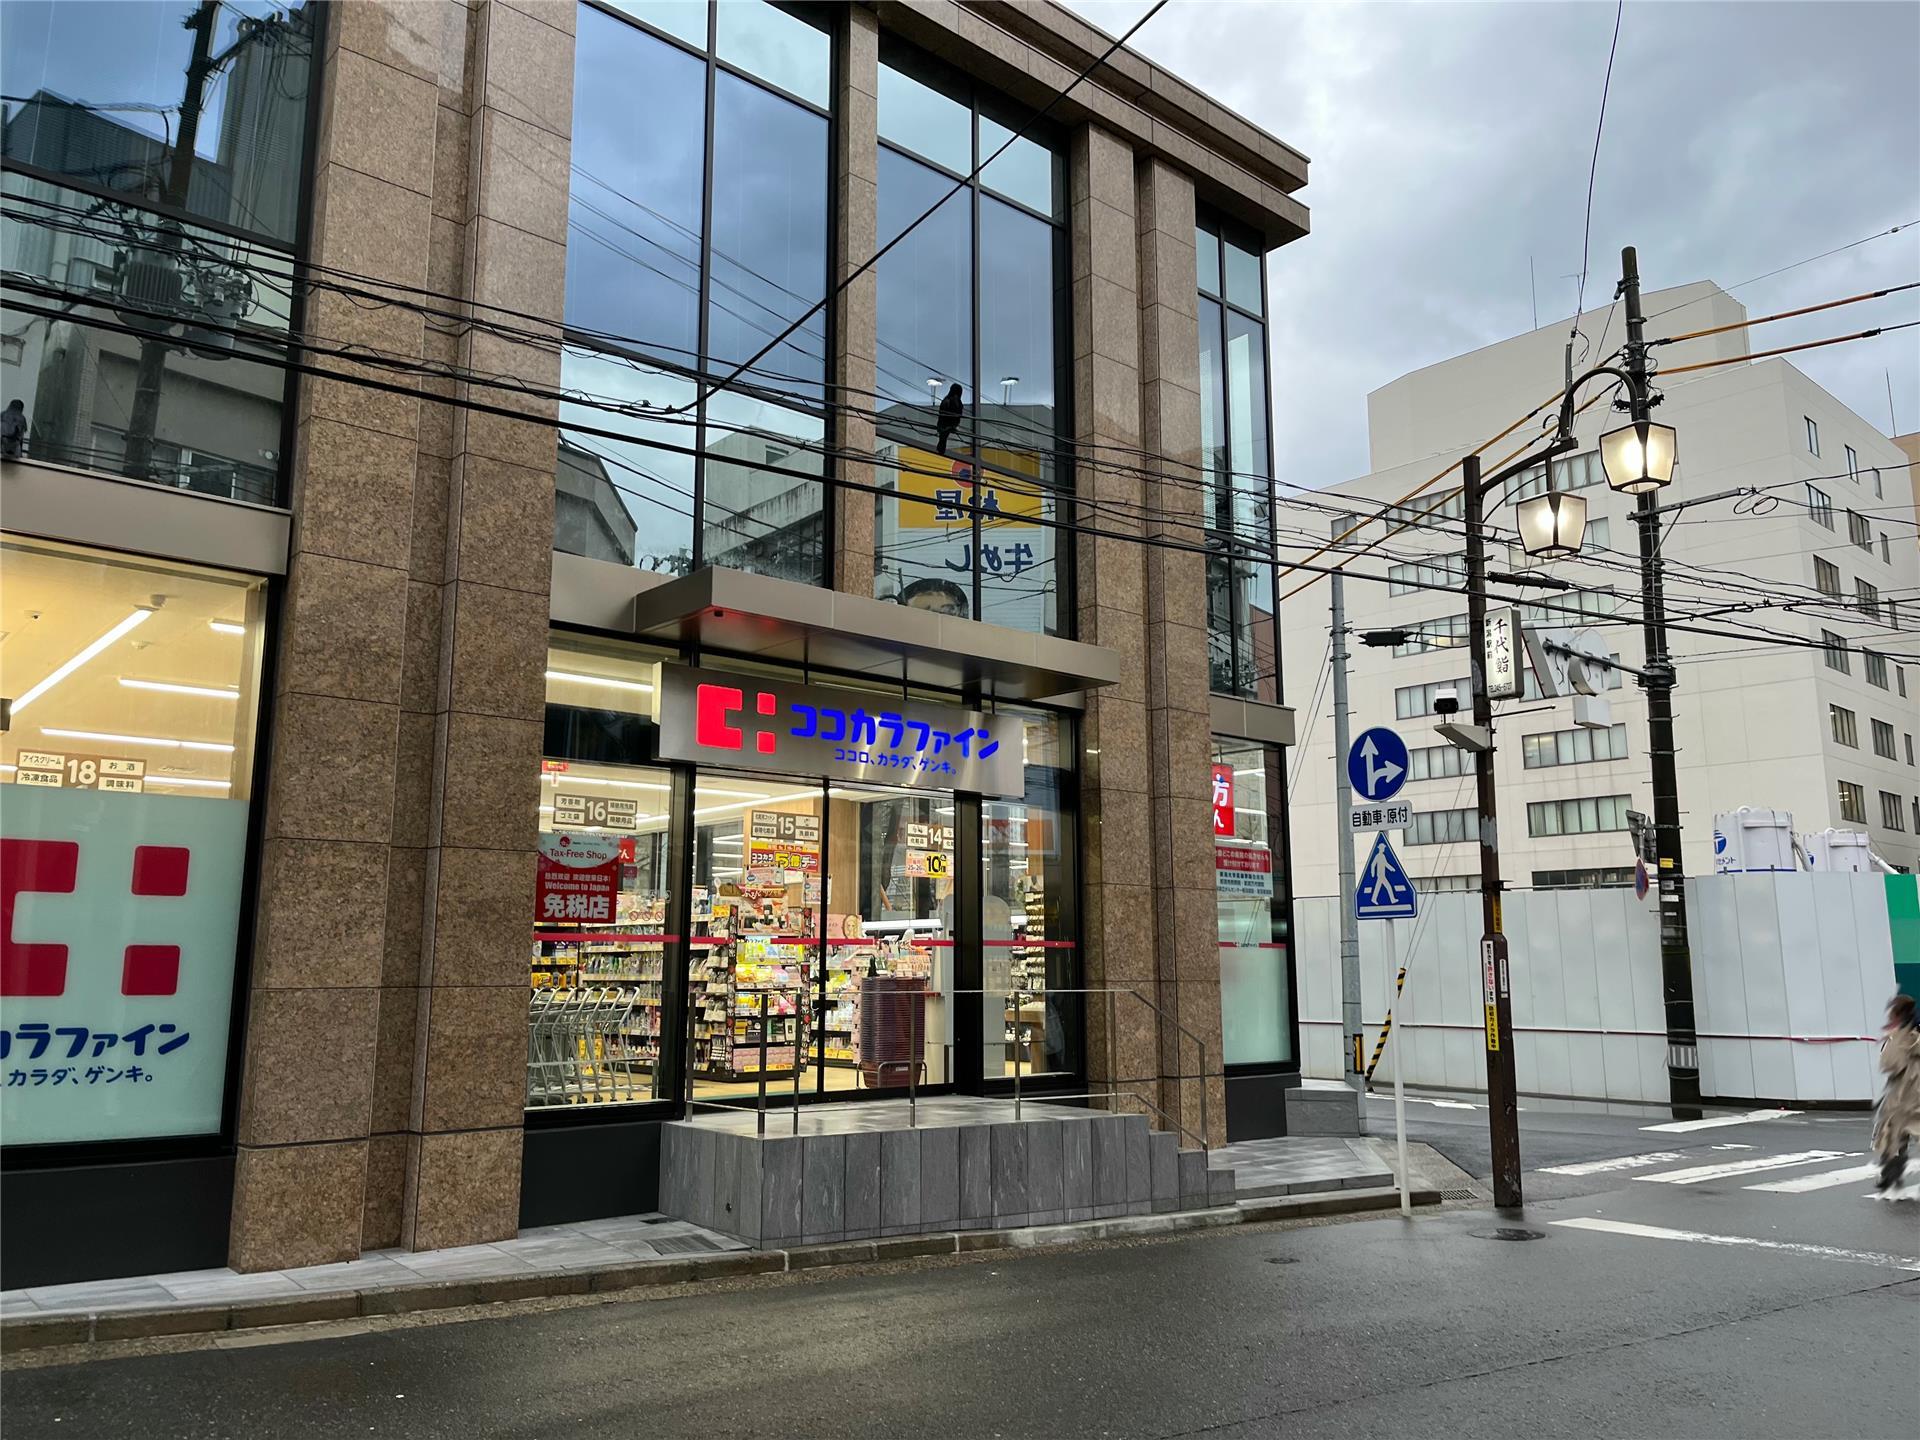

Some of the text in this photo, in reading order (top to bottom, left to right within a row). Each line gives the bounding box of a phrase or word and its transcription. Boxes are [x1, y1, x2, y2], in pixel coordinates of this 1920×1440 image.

[790, 704, 999, 760] ココカラファイン
[67, 759, 97, 785] 18
[834, 748, 958, 775] ココロ、カラダ、ゲンキ。
[587, 800, 606, 821] 16
[1352, 807, 1408, 827] 自動車・原付
[778, 816, 795, 835] 15
[928, 828, 942, 845] 14
[550, 848, 607, 861] Tax-Free Shop
[545, 882, 610, 892] Welcome to Japan
[543, 893, 610, 919] 免税店
[0, 1066, 153, 1087] カラダ、ゲンキ。
